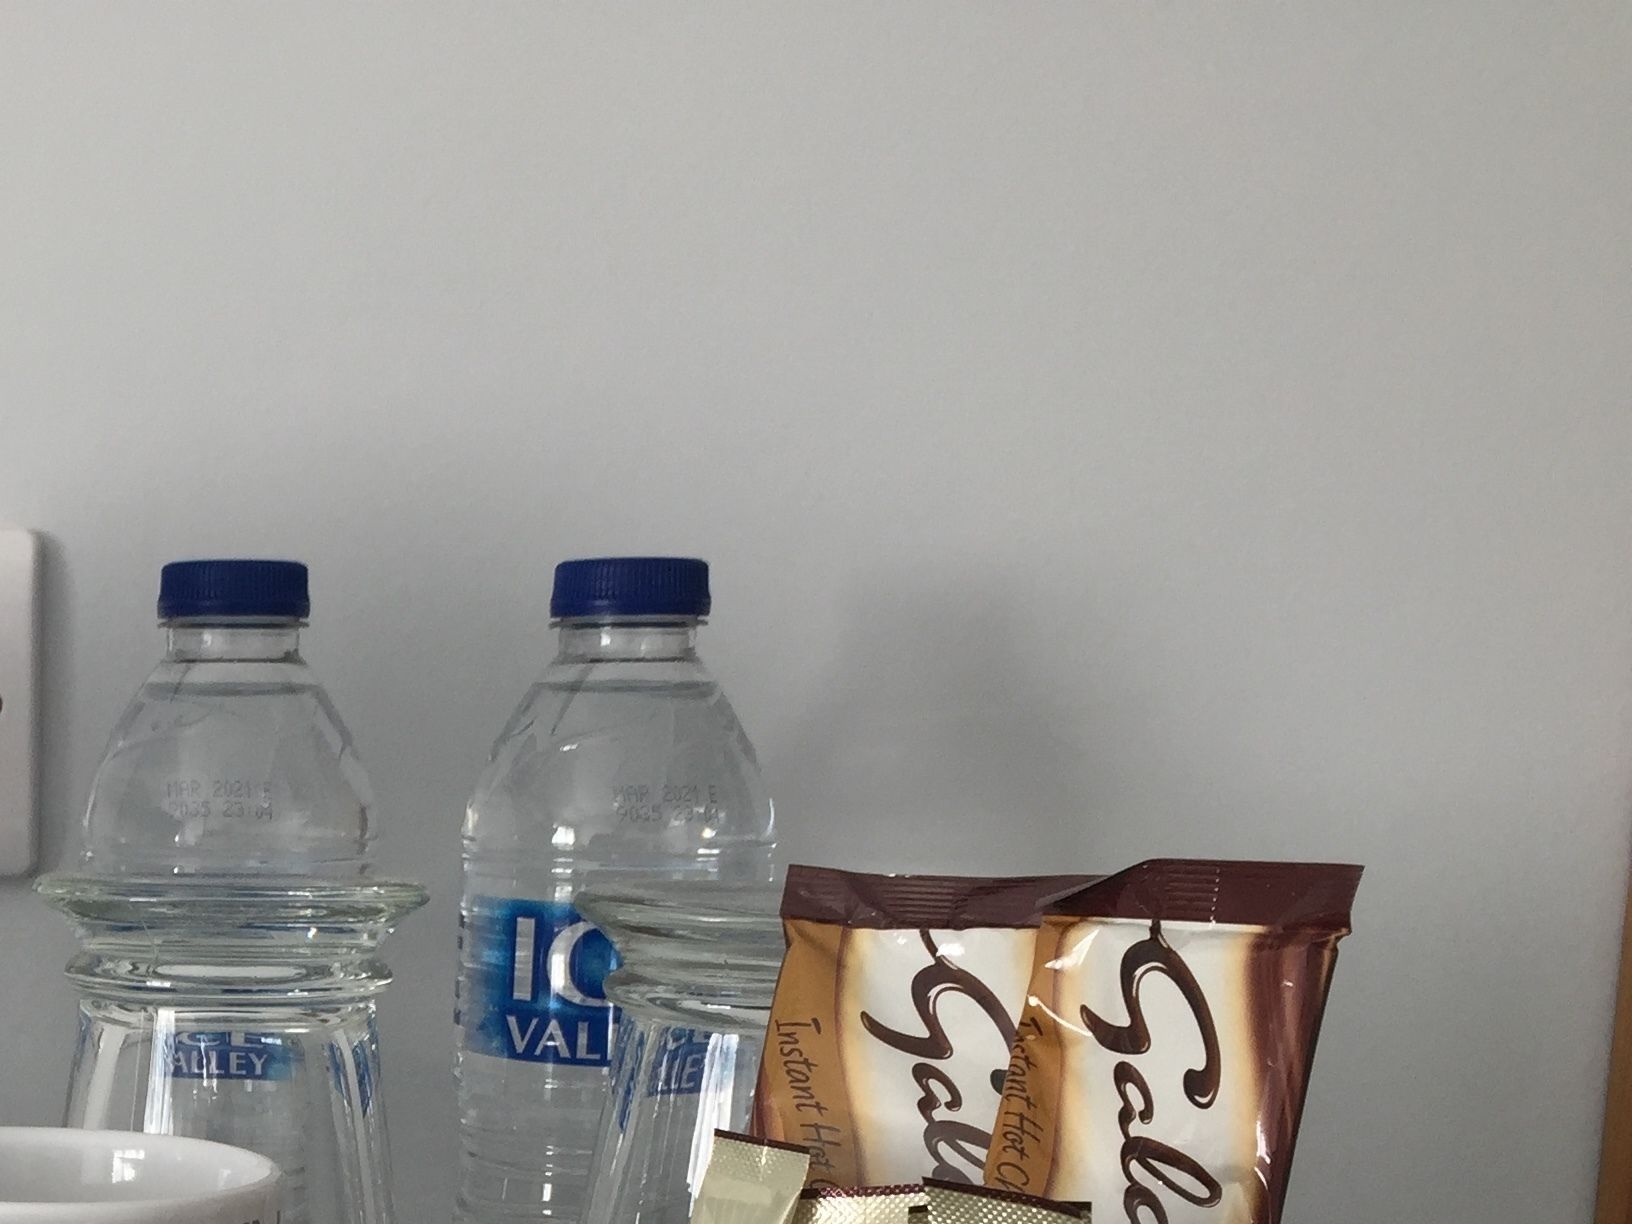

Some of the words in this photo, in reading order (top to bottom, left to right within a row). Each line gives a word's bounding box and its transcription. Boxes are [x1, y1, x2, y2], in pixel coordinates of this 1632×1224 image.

[512, 916, 615, 1007] IC
[171, 1051, 268, 1076] ALLEY
[774, 1017, 828, 1117] Instant
[860, 929, 1019, 1185] Gal
[1001, 1111, 1044, 1161] Hot
